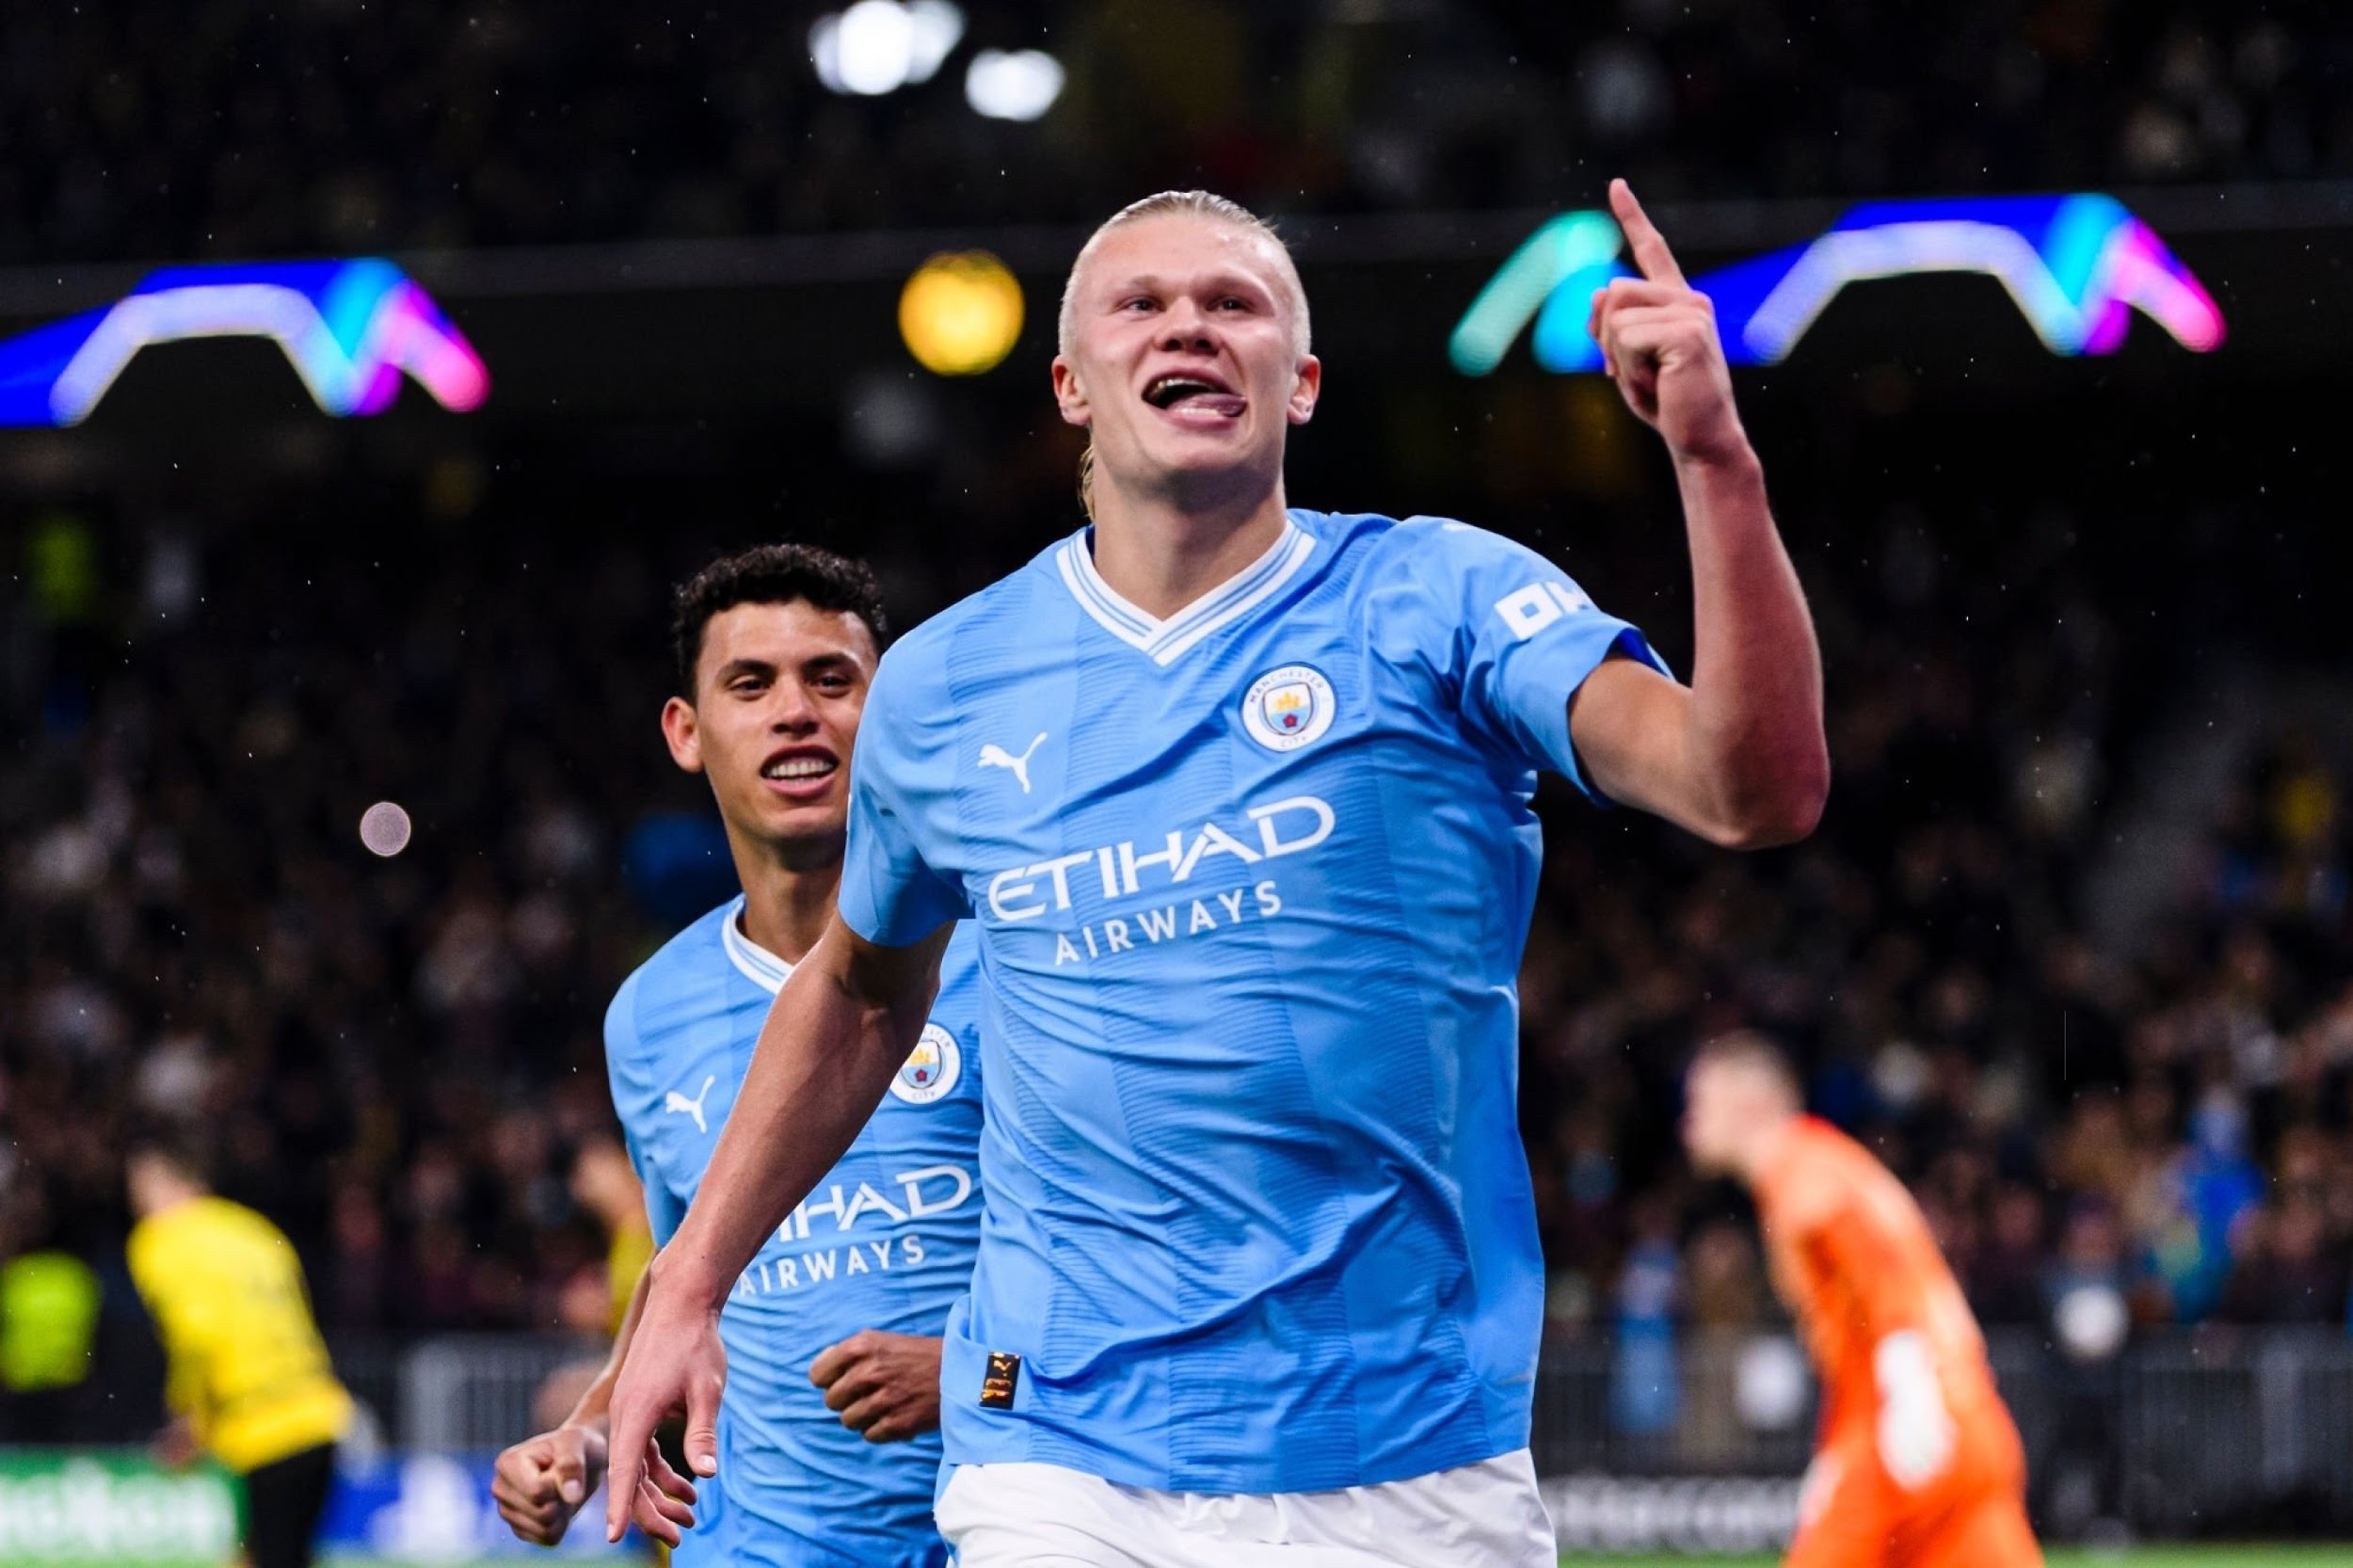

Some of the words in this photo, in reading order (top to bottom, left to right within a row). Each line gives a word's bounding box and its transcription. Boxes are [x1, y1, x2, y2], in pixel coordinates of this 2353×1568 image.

[1249, 669, 1324, 704] MANCHESTER
[987, 795, 1337, 921] ETIHAD
[1054, 879, 1283, 966] AIRWAYS
[778, 1164, 972, 1242] IHAD
[737, 1234, 925, 1298] AIRWAYS
